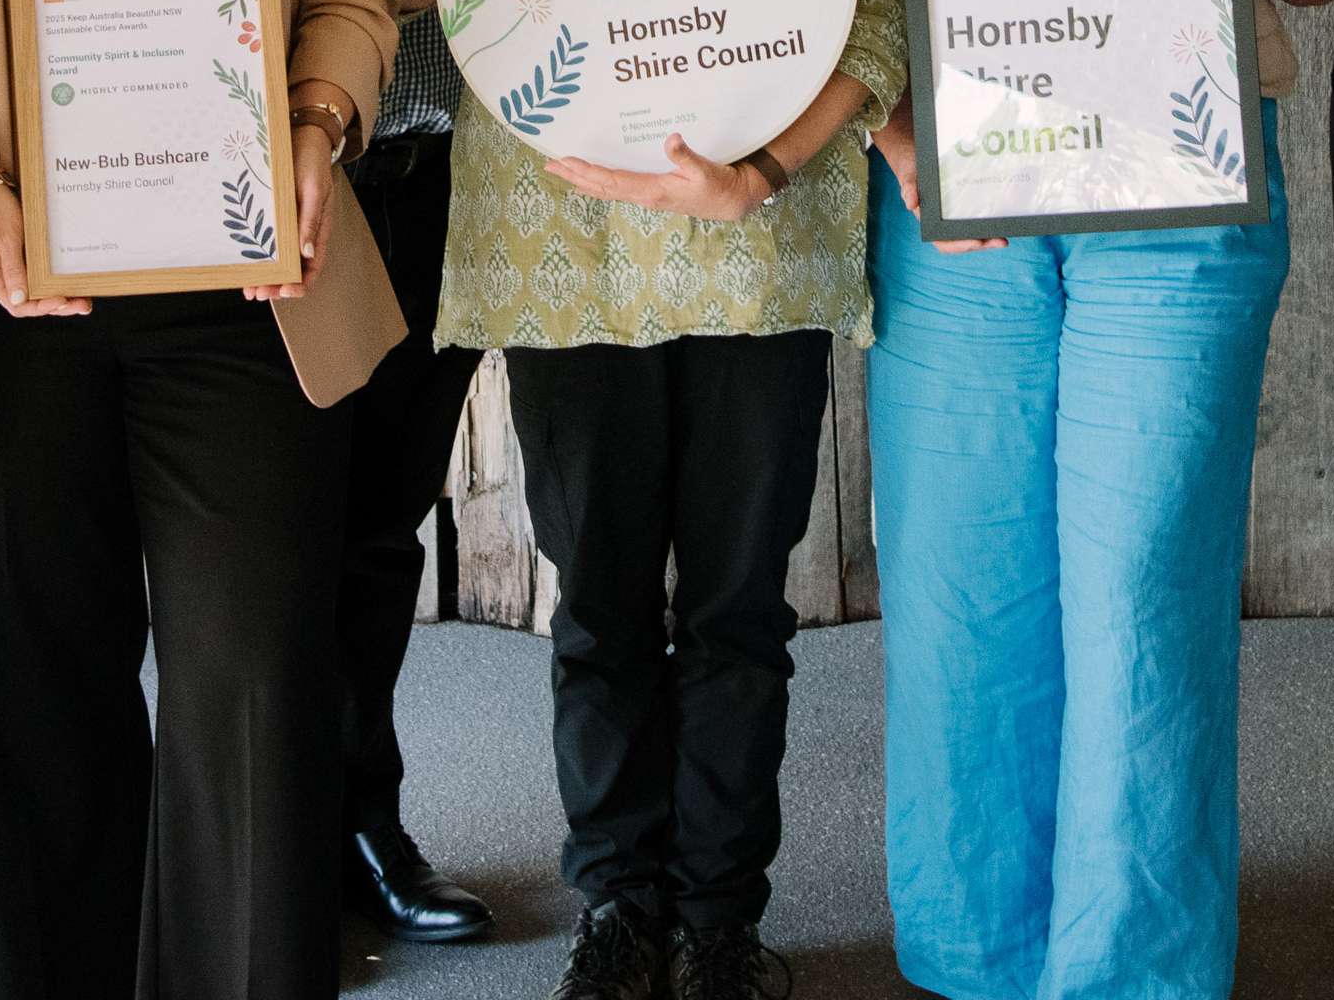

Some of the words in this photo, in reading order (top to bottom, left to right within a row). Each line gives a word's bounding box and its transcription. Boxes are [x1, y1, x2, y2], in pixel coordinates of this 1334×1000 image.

[45, 15, 65, 23] 2025
[67, 14, 87, 22] Keep
[89, 11, 124, 20] Australia
[126, 9, 161, 18] Beautiful
[163, 8, 182, 16] NSW
[46, 26, 92, 36] Sustainable
[94, 24, 116, 32] Cities
[119, 22, 148, 30] Awards
[608, 6, 727, 45] Hornsby
[946, 6, 1113, 50] Hornsby
[48, 52, 102, 64] Community
[105, 50, 130, 61] Spirit
[133, 50, 139, 58] &
[142, 48, 184, 58] Inclusion
[614, 52, 689, 82] Shire
[697, 29, 805, 69] Council
[49, 66, 78, 76] Award
[81, 86, 118, 95] HIGHLY
[123, 82, 189, 92] COMMENDED
[957, 65, 1053, 98] hire
[622, 124, 627, 132] 6
[629, 118, 672, 130] November
[675, 113, 697, 124] 2025
[624, 131, 667, 144] Blacktown
[56, 153, 130, 172] New-Bub
[135, 150, 209, 166] Bushcare
[57, 179, 101, 193] Hornsby
[104, 179, 132, 190] Shire
[134, 176, 175, 188] Council
[66, 243, 100, 252] November
